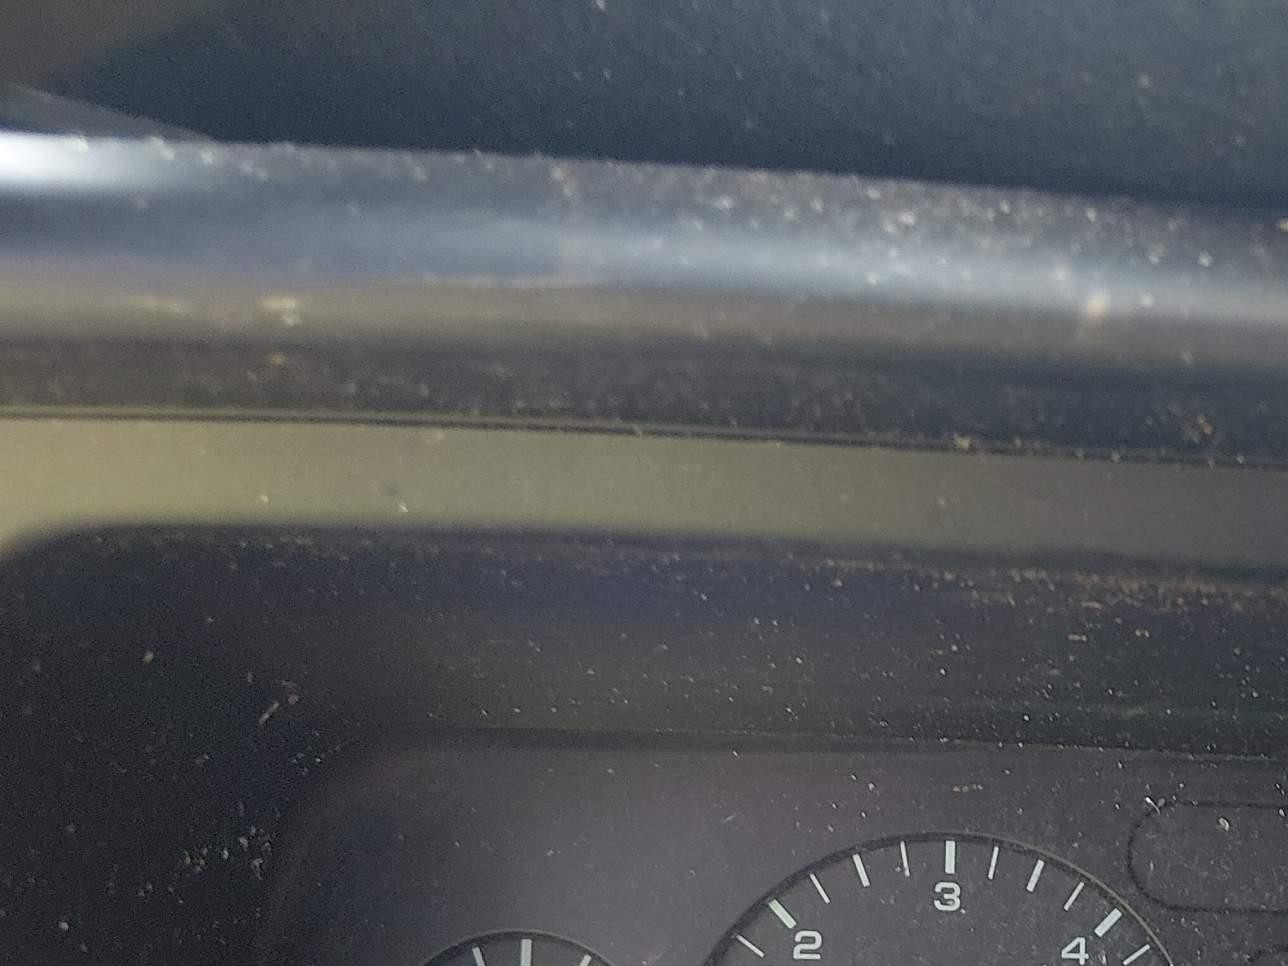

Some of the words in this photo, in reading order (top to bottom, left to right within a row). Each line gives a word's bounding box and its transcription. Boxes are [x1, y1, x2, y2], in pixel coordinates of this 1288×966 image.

[934, 882, 961, 911] 3
[793, 931, 821, 960] 2
[1061, 938, 1089, 965] 4
